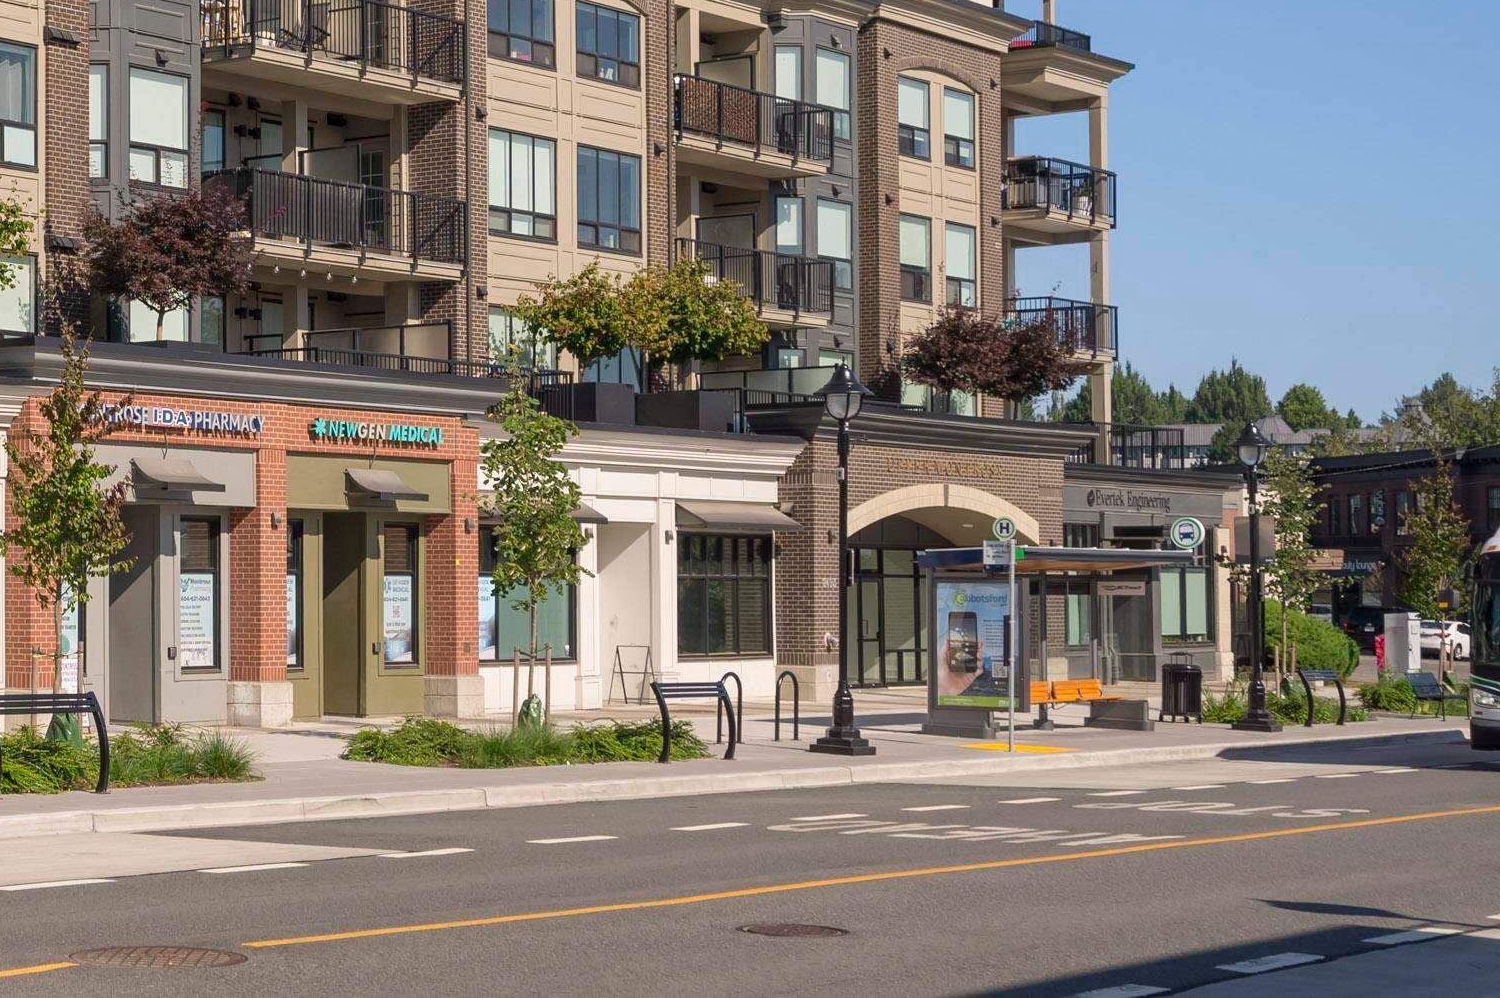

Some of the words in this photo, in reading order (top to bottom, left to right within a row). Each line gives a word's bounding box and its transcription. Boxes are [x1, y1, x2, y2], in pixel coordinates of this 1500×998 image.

[191, 410, 265, 434] PHARMACY
[328, 419, 387, 440] NEWGEN
[388, 424, 444, 444] MEDICAL
[1126, 490, 1171, 514] Engineering
[1072, 800, 1371, 818] STOP
[766, 820, 1188, 846] AHEAD
